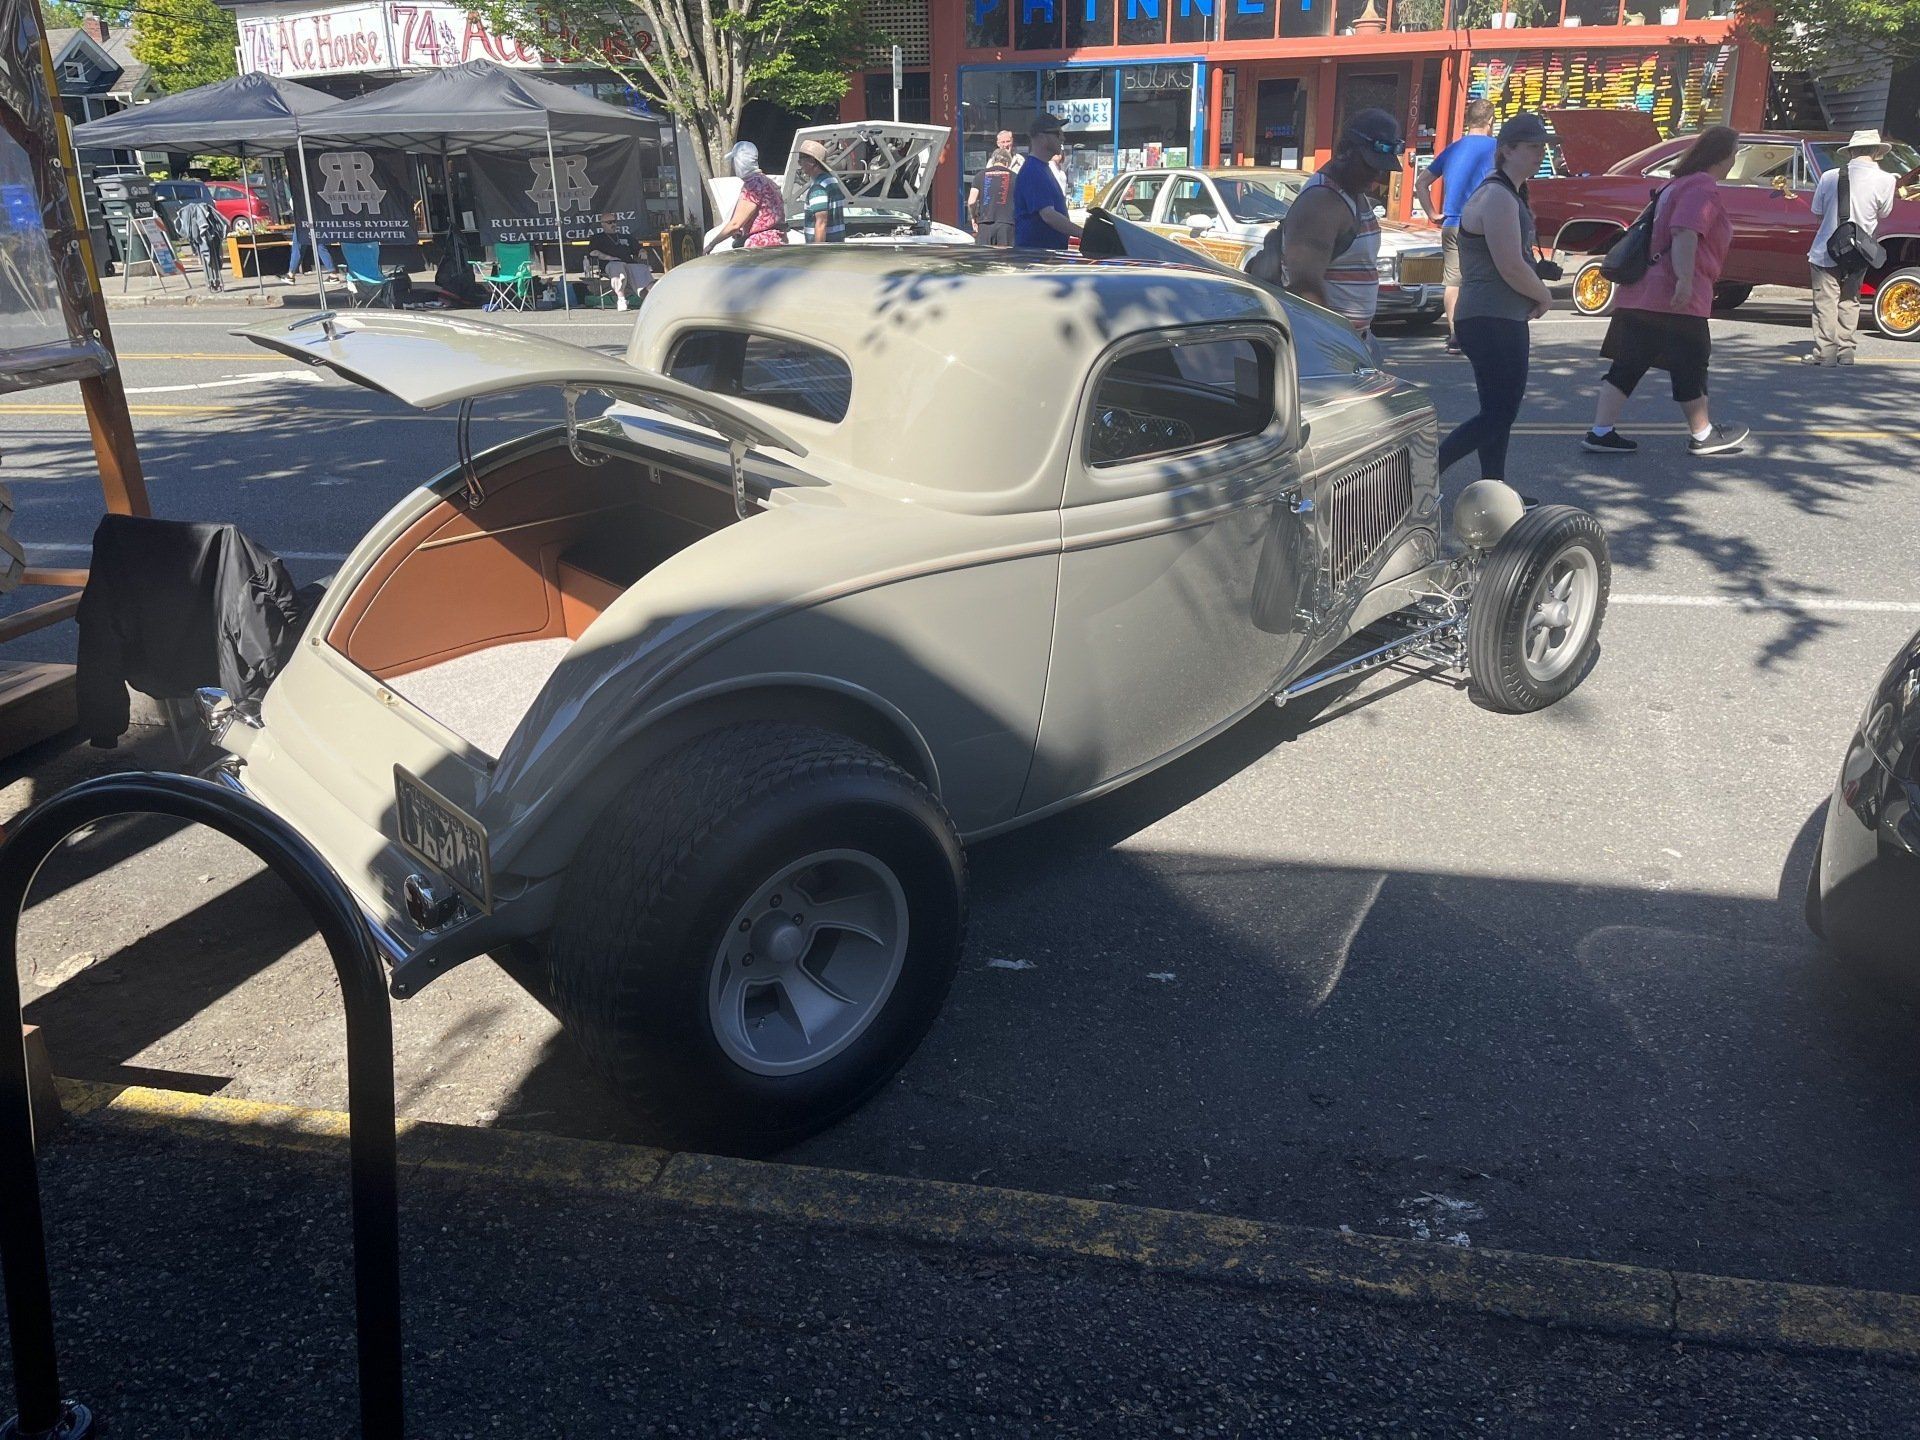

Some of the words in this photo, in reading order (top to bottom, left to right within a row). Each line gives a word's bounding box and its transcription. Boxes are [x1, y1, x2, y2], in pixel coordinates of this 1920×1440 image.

[974, 0, 1311, 26] PHINN
[278, 18, 316, 73] Ale
[312, 14, 383, 69] House
[1125, 64, 1192, 89] BOOKS
[1049, 102, 1109, 114] PHINNEY
[1066, 113, 1109, 124] BOOKS
[364, 220, 410, 228] RYDERZ
[576, 210, 636, 225] RYDRZ
[357, 230, 406, 239] CHAPTER
[565, 225, 631, 239] CHAPER
